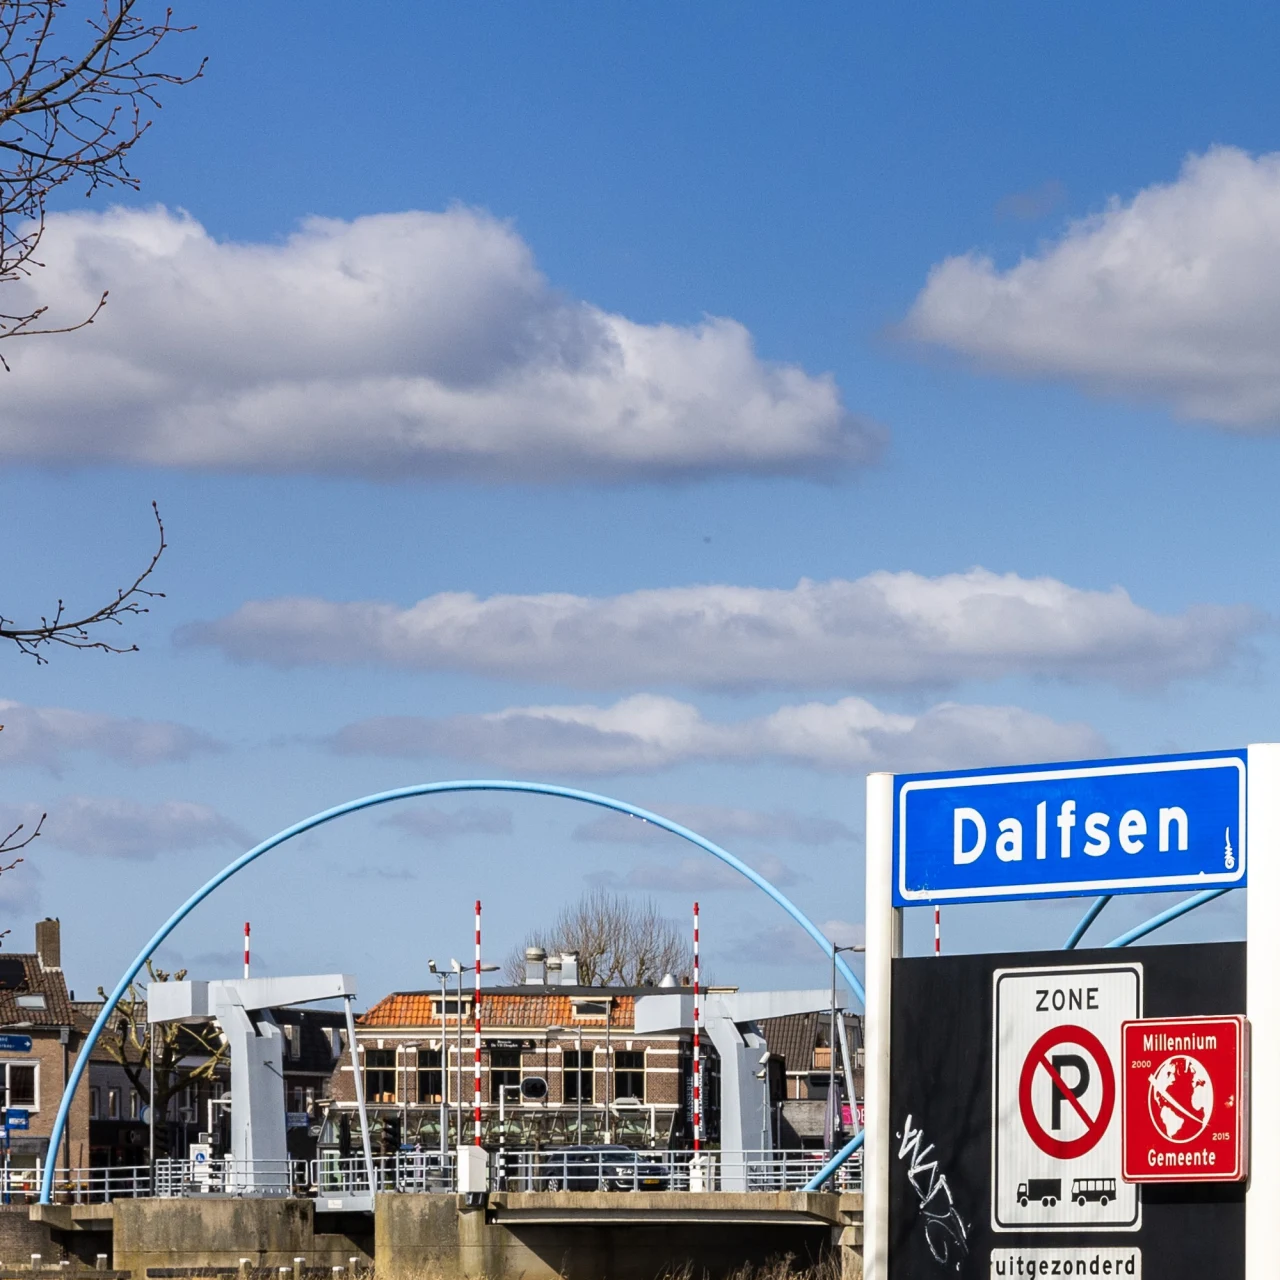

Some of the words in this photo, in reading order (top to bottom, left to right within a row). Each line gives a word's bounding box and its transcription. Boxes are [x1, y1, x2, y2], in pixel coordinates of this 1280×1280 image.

[953, 800, 1188, 865] Dalfsen
[1036, 987, 1099, 1012] ZONE
[1143, 1033, 1217, 1051] Millennium
[1131, 1060, 1151, 1069] 2000
[1212, 1132, 1230, 1141] 2015
[1148, 1148, 1216, 1167] Gemeente
